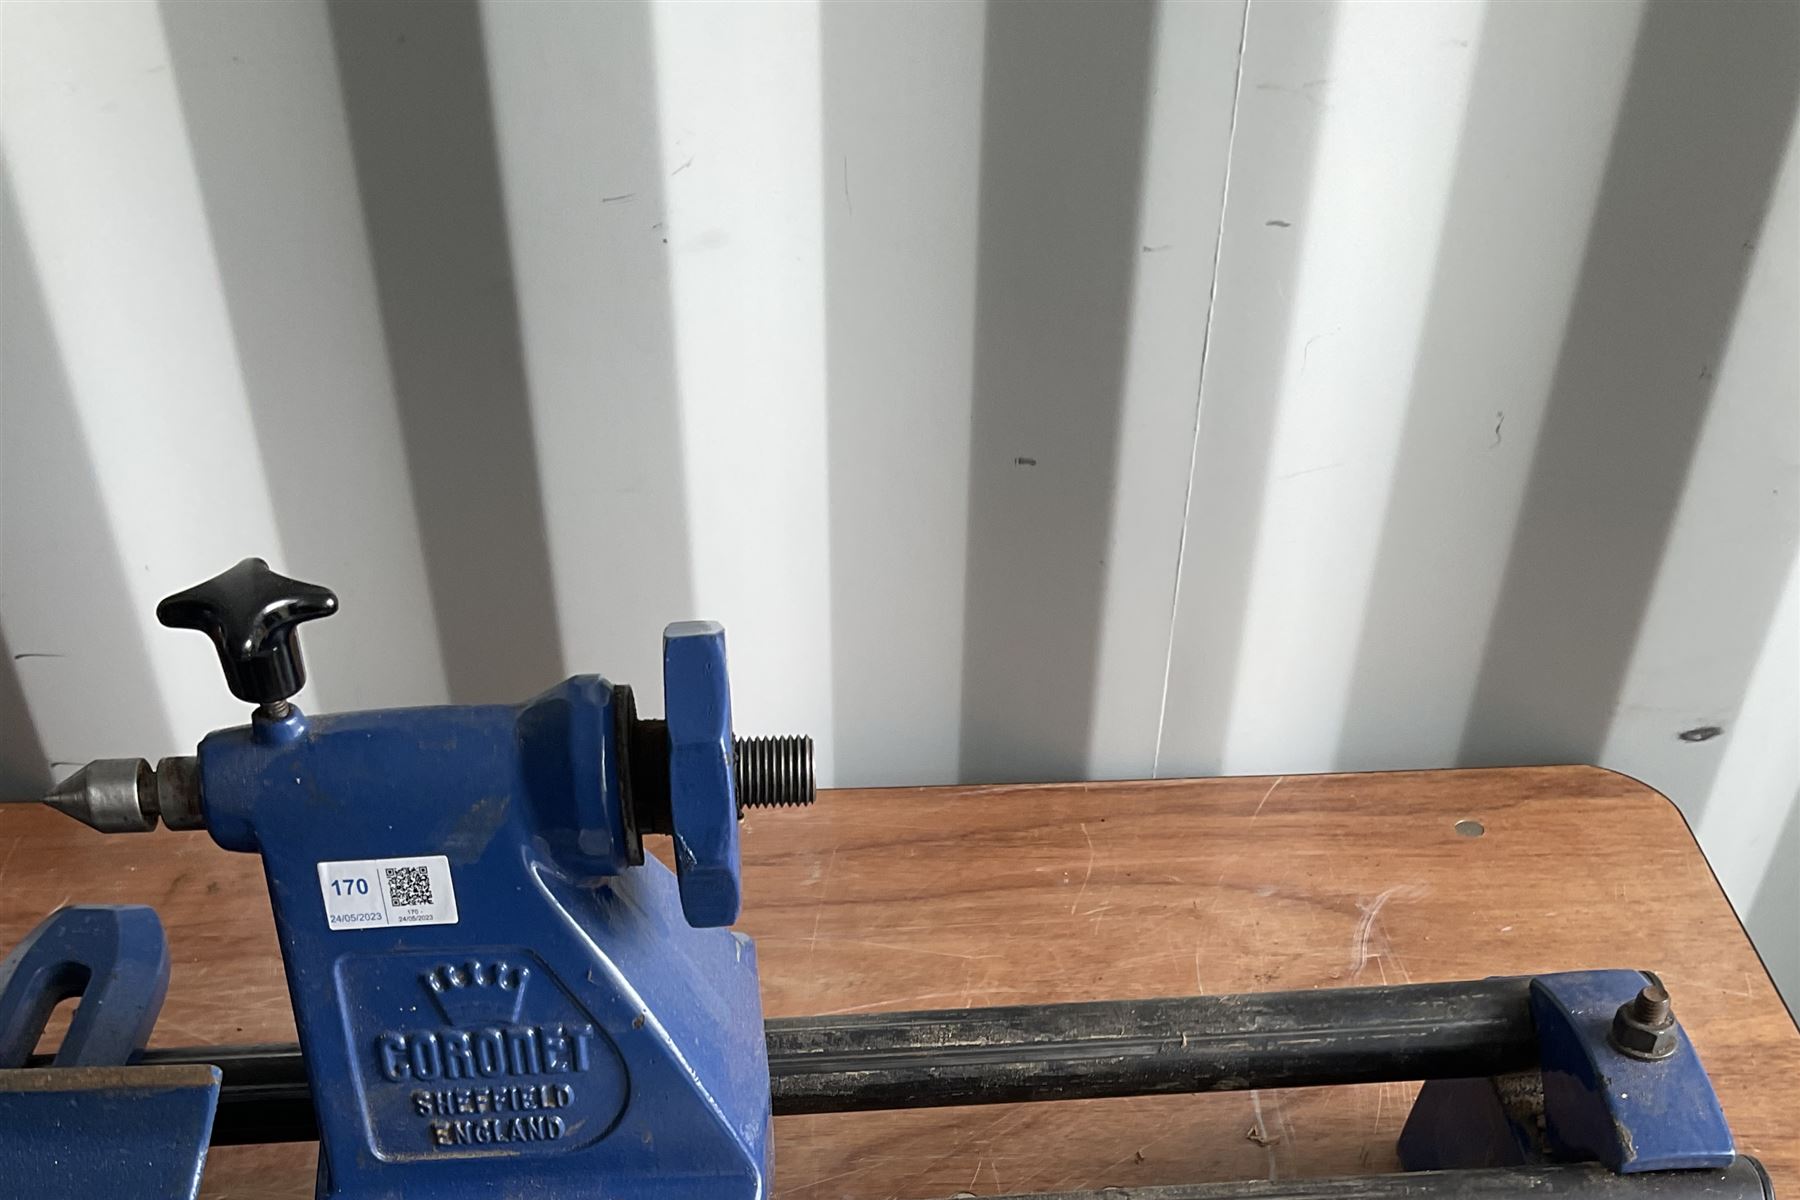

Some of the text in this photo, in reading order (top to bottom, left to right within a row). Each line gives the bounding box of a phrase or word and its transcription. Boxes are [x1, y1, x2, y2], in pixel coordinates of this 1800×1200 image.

[331, 878, 369, 896] 170
[330, 912, 383, 923] 24/05/2023
[375, 1023, 594, 1082] CORONET
[410, 1083, 576, 1118] SHEFFIELD
[432, 1114, 567, 1145] ENGLAND
